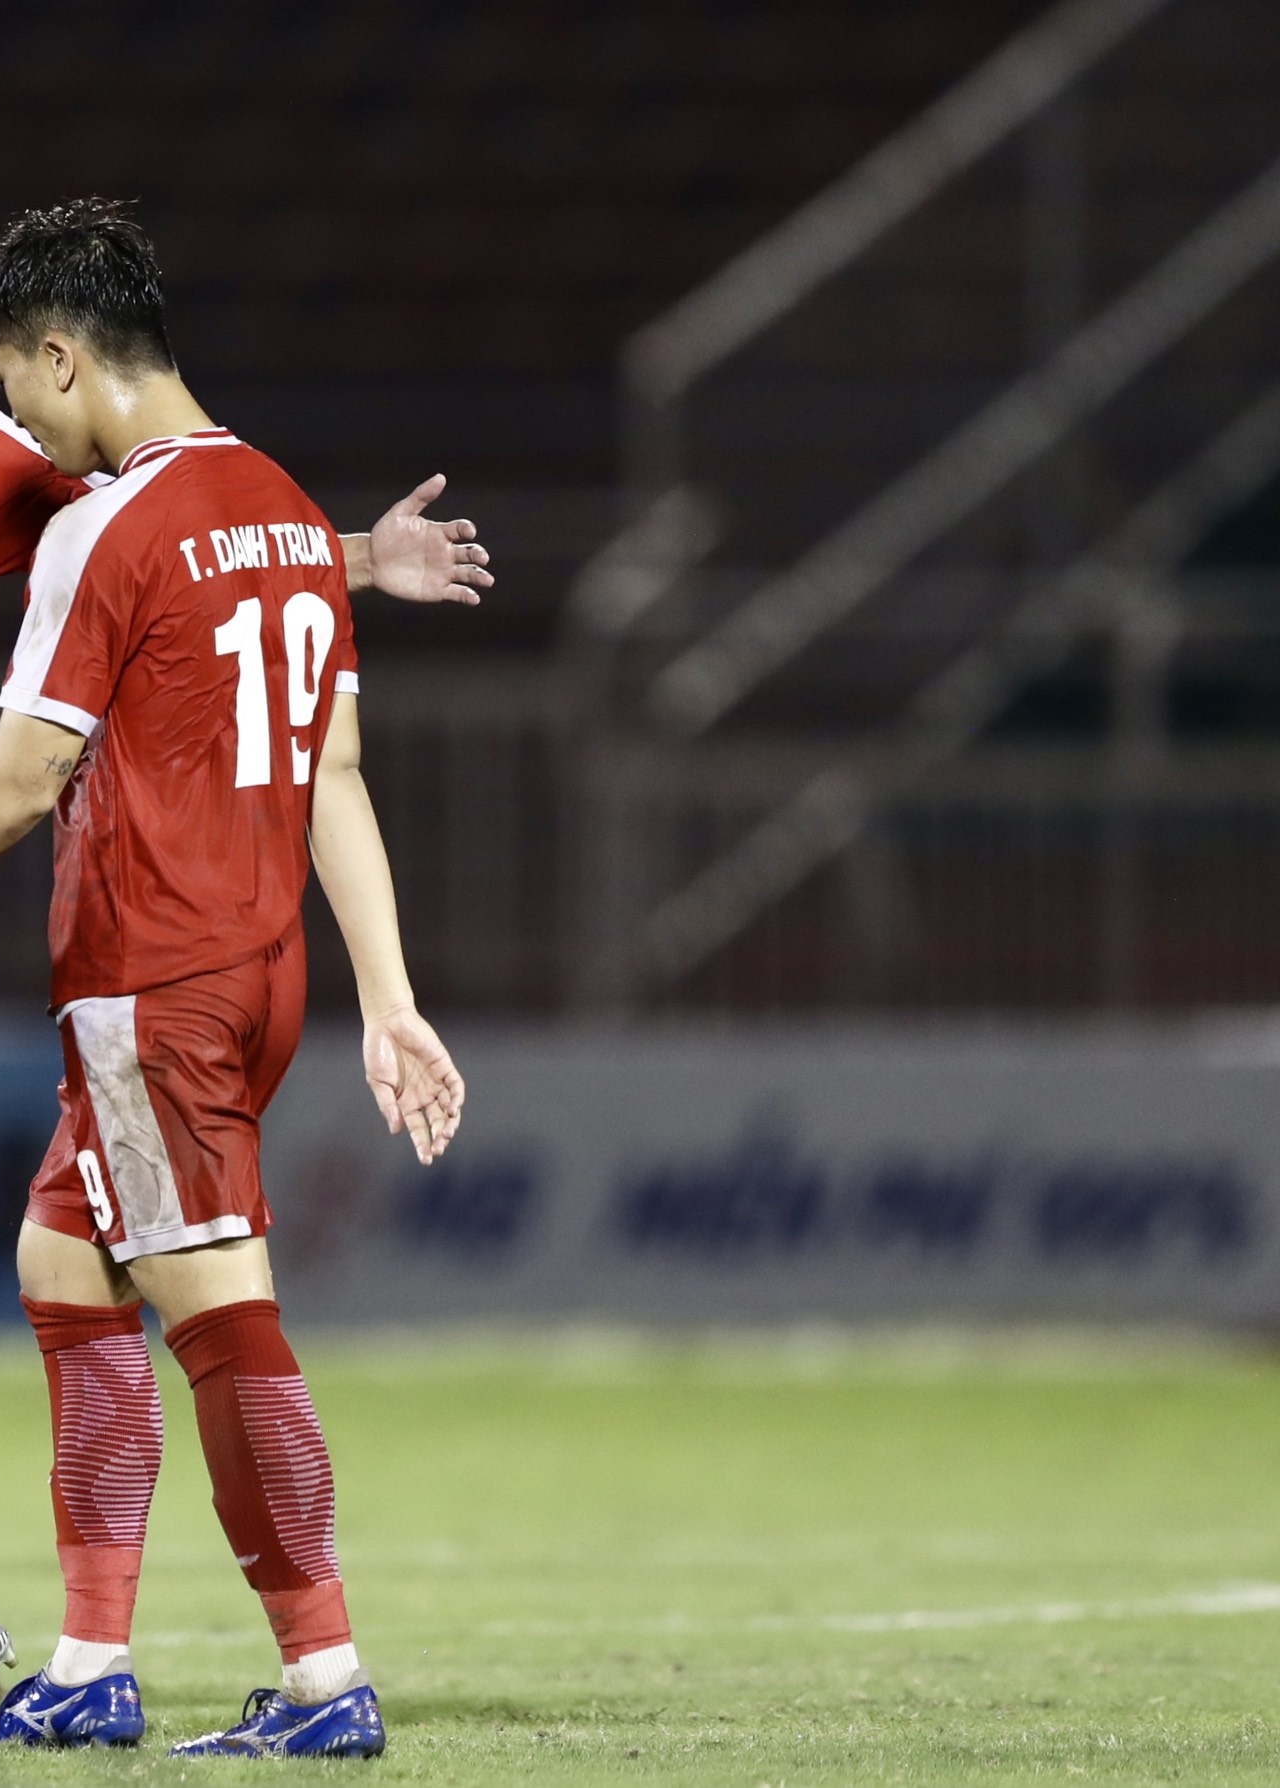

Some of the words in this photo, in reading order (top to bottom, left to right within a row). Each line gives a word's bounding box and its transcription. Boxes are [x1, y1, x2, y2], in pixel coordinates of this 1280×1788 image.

[179, 537, 214, 582] T.
[214, 591, 335, 789] 19
[76, 1148, 114, 1232] 9
